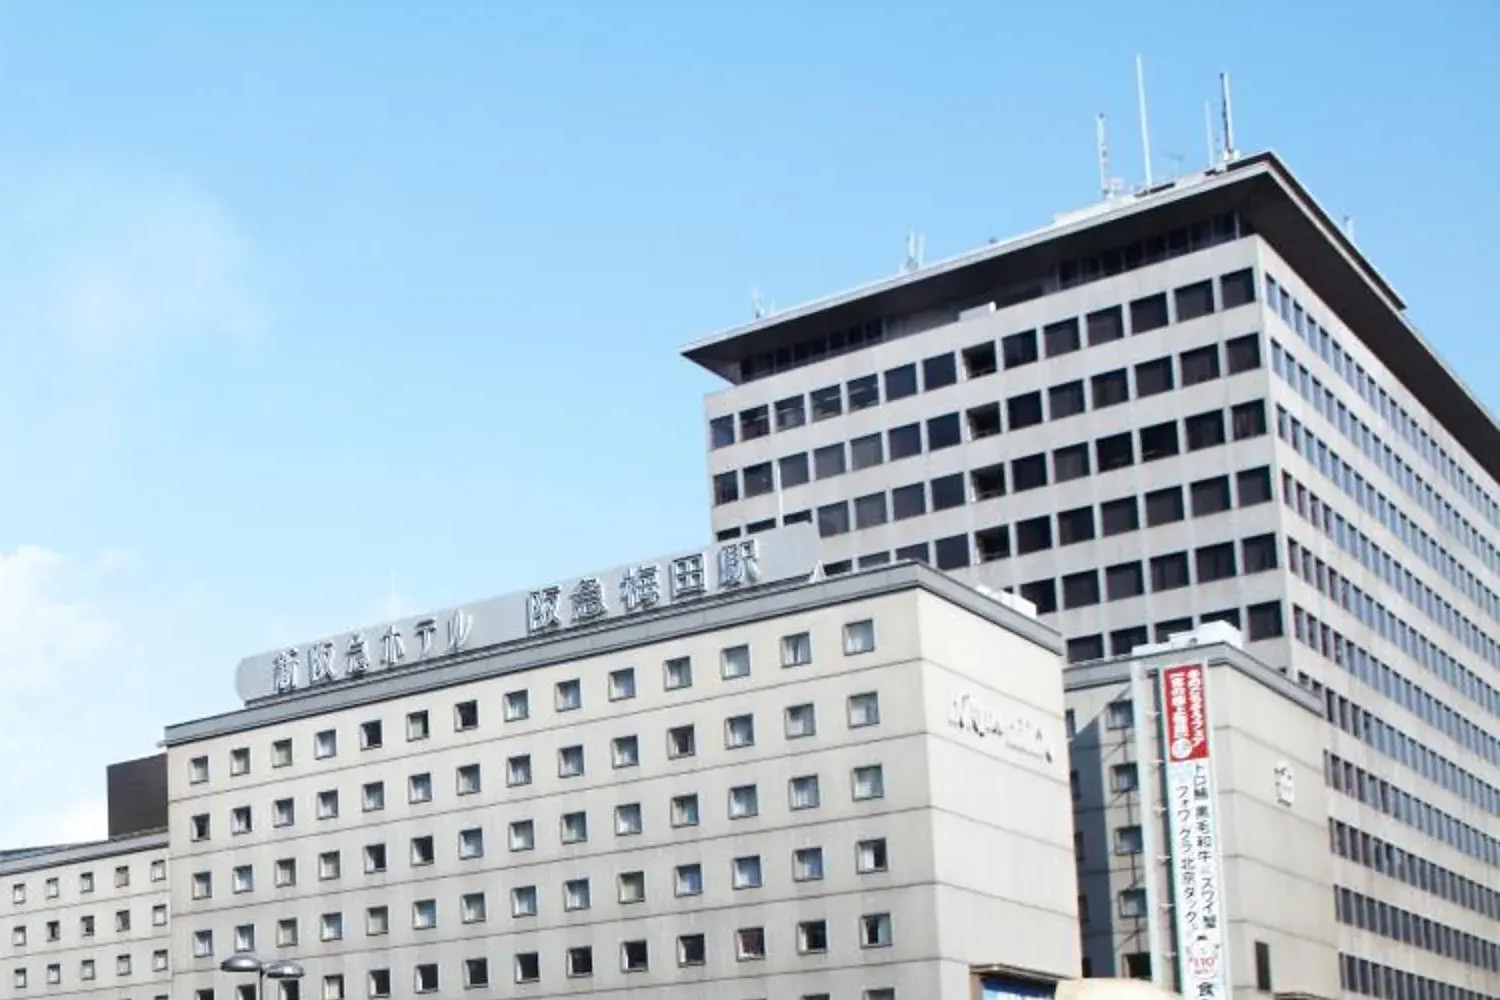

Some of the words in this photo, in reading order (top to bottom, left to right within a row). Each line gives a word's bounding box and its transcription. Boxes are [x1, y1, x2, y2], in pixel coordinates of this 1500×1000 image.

[272, 609, 474, 695] 新阪急ホテル
[526, 538, 763, 634] 阪急梅田駅
